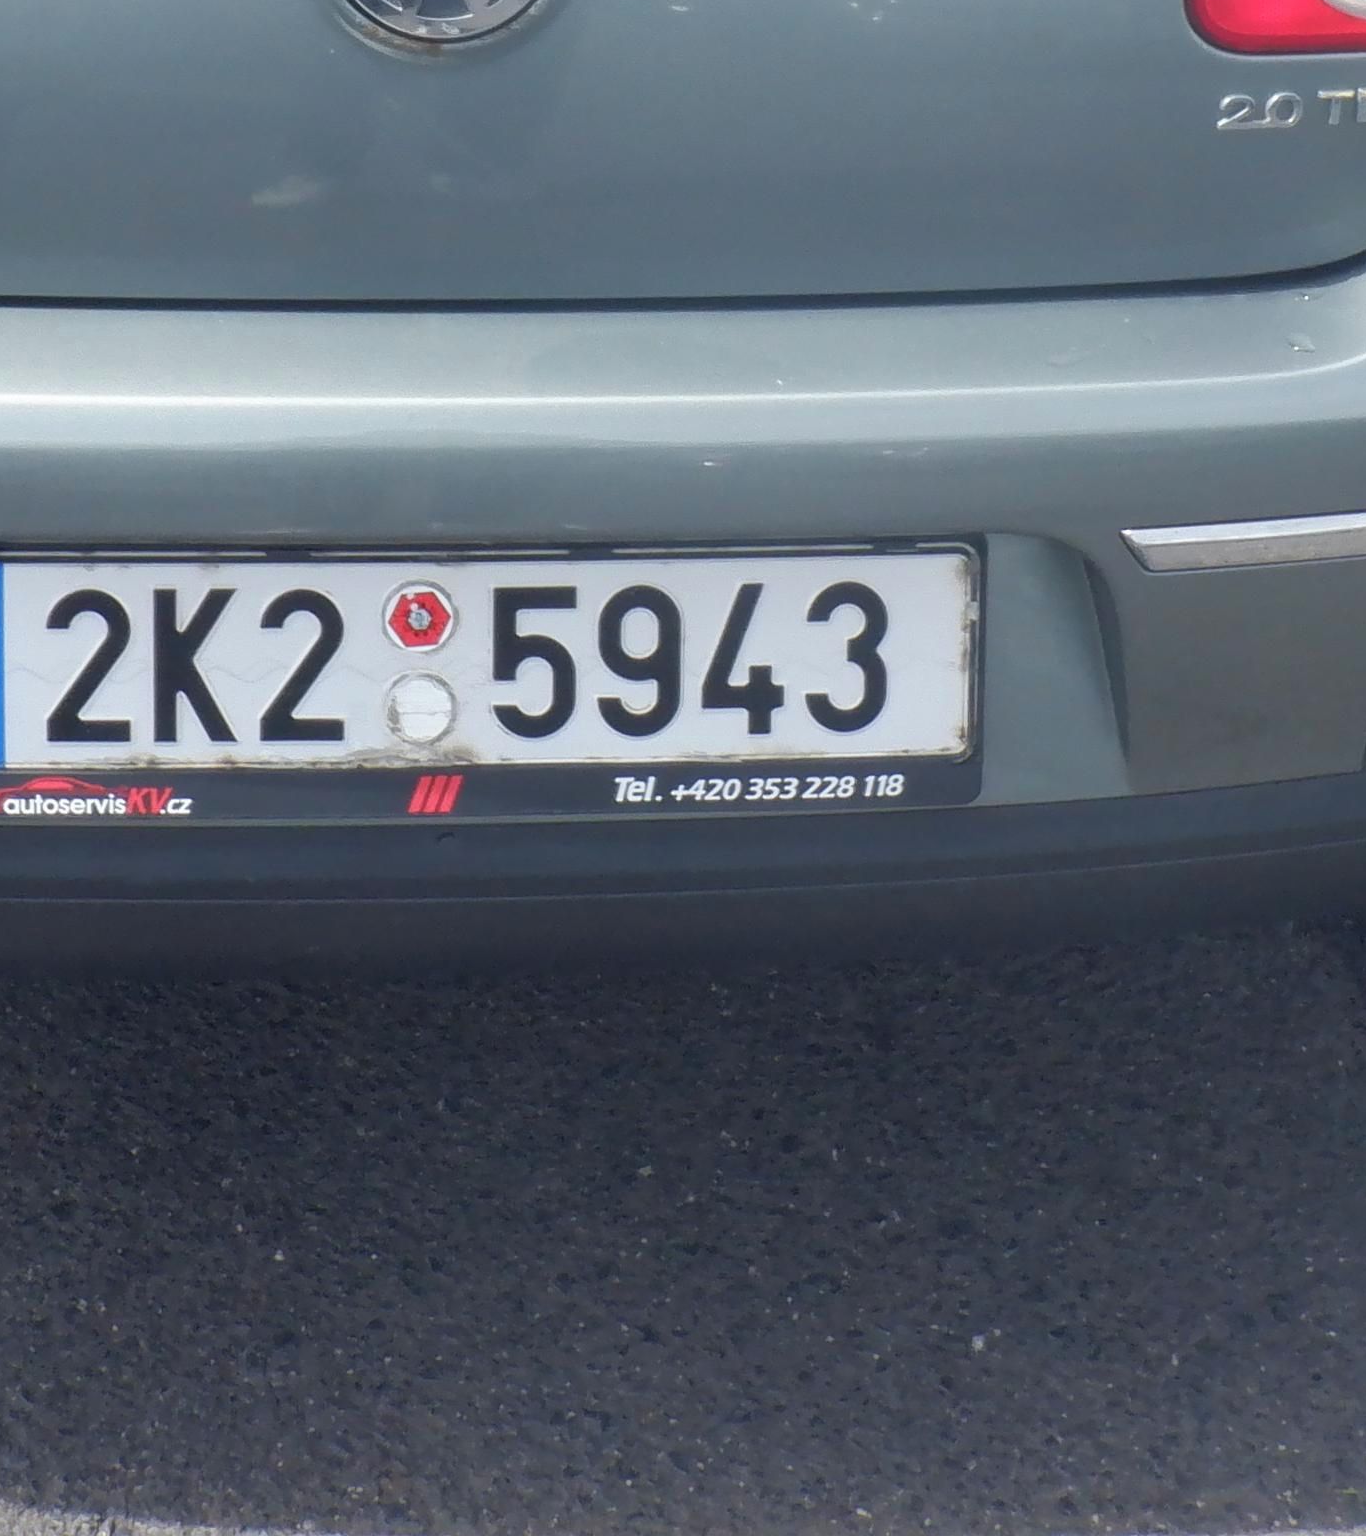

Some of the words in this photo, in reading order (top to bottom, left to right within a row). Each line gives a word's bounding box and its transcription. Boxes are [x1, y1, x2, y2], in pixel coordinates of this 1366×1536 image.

[46, 588, 345, 743] 2K2
[492, 581, 889, 739] 5943
[2, 786, 193, 815] autoservisKV.cz
[615, 776, 663, 802] Tel.
[671, 777, 742, 802] +420
[744, 777, 799, 800] 353
[801, 775, 855, 799] 228
[863, 773, 906, 797] 118
